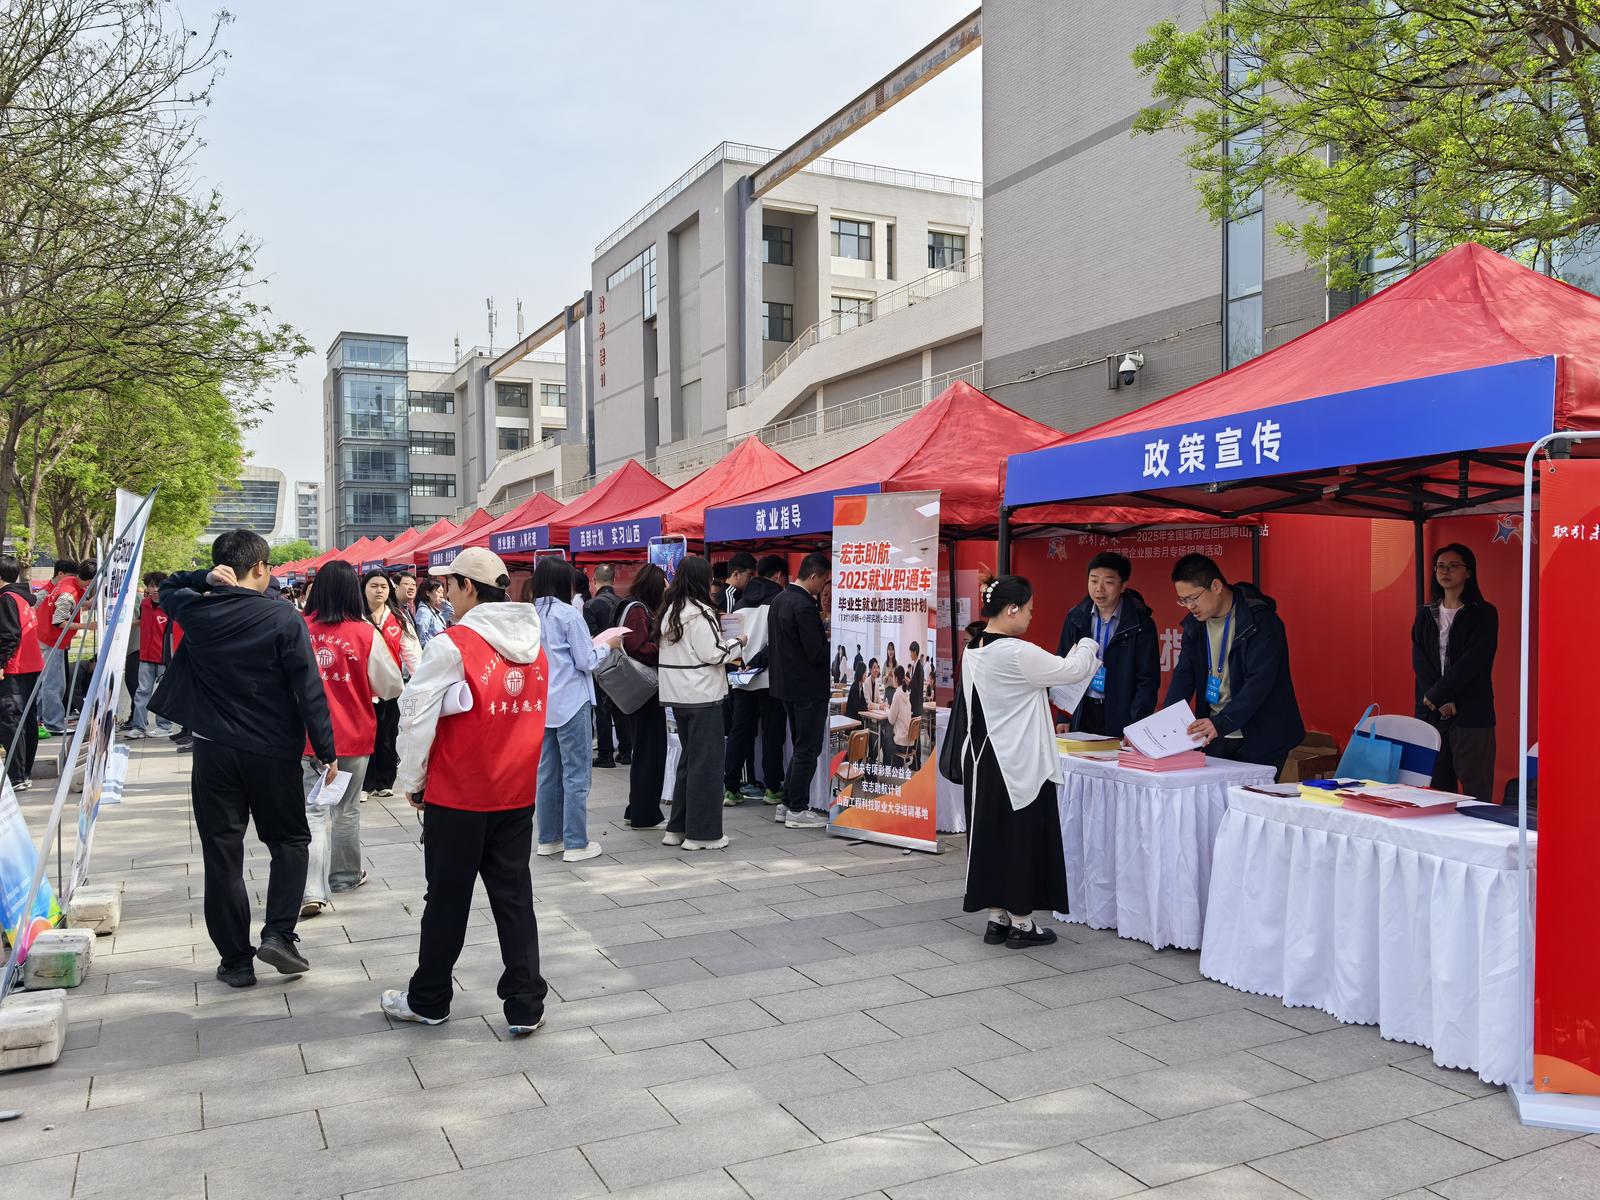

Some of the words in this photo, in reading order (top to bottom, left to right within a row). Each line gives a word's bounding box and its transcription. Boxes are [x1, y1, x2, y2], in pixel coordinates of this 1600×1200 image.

[1142, 419, 1282, 478] 政策宣传
[755, 503, 801, 532] 就业指导
[580, 528, 604, 548] 西部计划
[611, 524, 640, 545] 实习山西
[840, 542, 891, 565] 宏志助航
[838, 568, 932, 592] 2025就业职通车
[838, 596, 928, 613] 毕业生就业加速陪跑计划
[488, 699, 544, 716] 青年志愿者
[852, 761, 912, 780] 中央专项彩票公益金
[861, 780, 902, 797] 宏志助航计划
[836, 795, 929, 820] 山西工程科技职业大学培训基地
